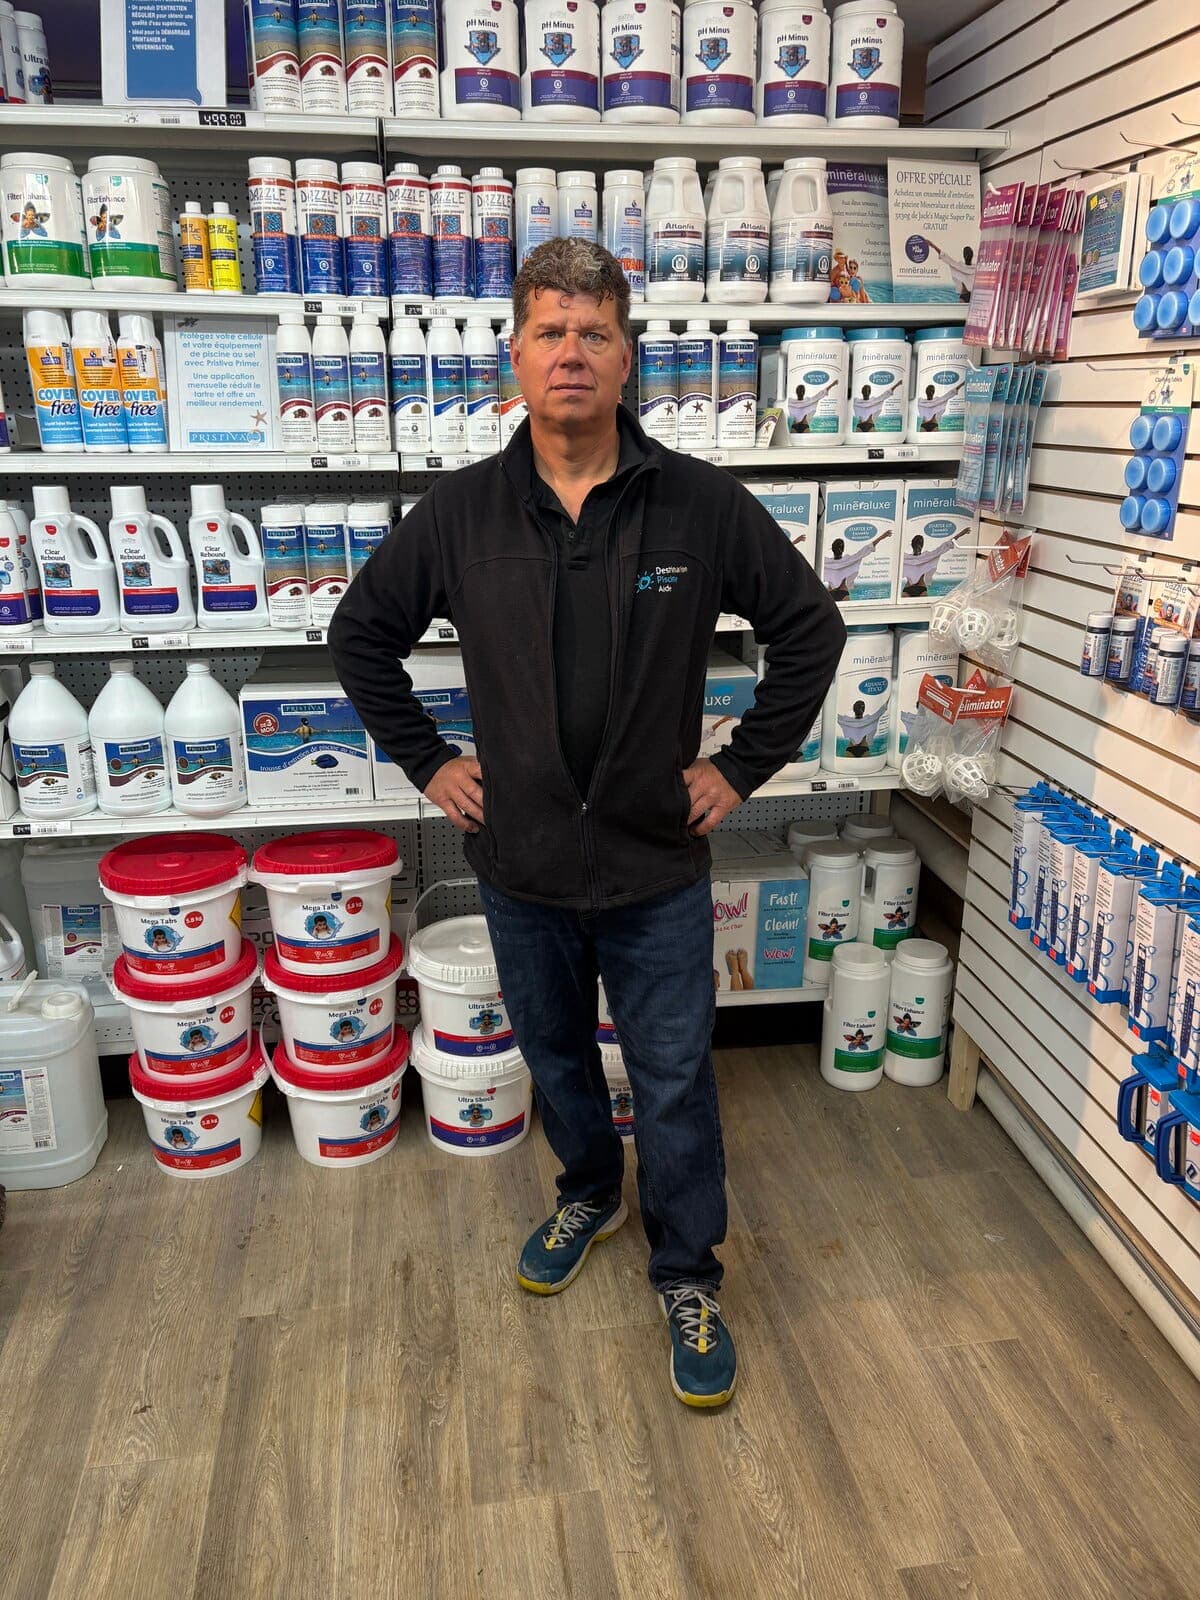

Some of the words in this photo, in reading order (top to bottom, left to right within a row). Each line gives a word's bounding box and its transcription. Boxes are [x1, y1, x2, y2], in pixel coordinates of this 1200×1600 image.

[466, 19, 477, 28] pH
[478, 18, 499, 28] Minus
[542, 21, 551, 30] pH
[552, 20, 575, 29] Minus
[611, 26, 620, 34] pH
[622, 24, 642, 32] Minus
[698, 28, 708, 37] pH
[708, 26, 730, 35] Minus
[777, 35, 786, 44] pH
[788, 34, 809, 42] Minus
[851, 38, 860, 46] pH
[862, 36, 883, 45] Minus
[896, 170, 926, 184] OFFRE
[928, 171, 972, 186] SPÉCIALE
[923, 222, 948, 231] GRATUIT
[180, 332, 214, 341] Protégez
[214, 341, 262, 350] équipement
[202, 351, 230, 359] piscine
[192, 372, 208, 380] Une
[210, 372, 254, 382] application
[38, 388, 76, 400] COVER
[81, 390, 120, 401] COVER
[194, 390, 215, 398] tartre
[216, 390, 224, 398] et
[226, 390, 244, 398] offre
[50, 400, 76, 417] free
[93, 400, 120, 418] free
[130, 401, 157, 416] free
[192, 432, 248, 441] PRISTIVA
[44, 548, 60, 556] Clear
[960, 698, 1004, 712] eliminator
[770, 892, 798, 906] Fast!
[302, 904, 320, 912] Mega
[713, 892, 749, 921] OW!
[140, 918, 158, 926] Mega
[764, 918, 800, 932] Clean!
[177, 1020, 196, 1028] Mega
[198, 1016, 214, 1024] Tabs
